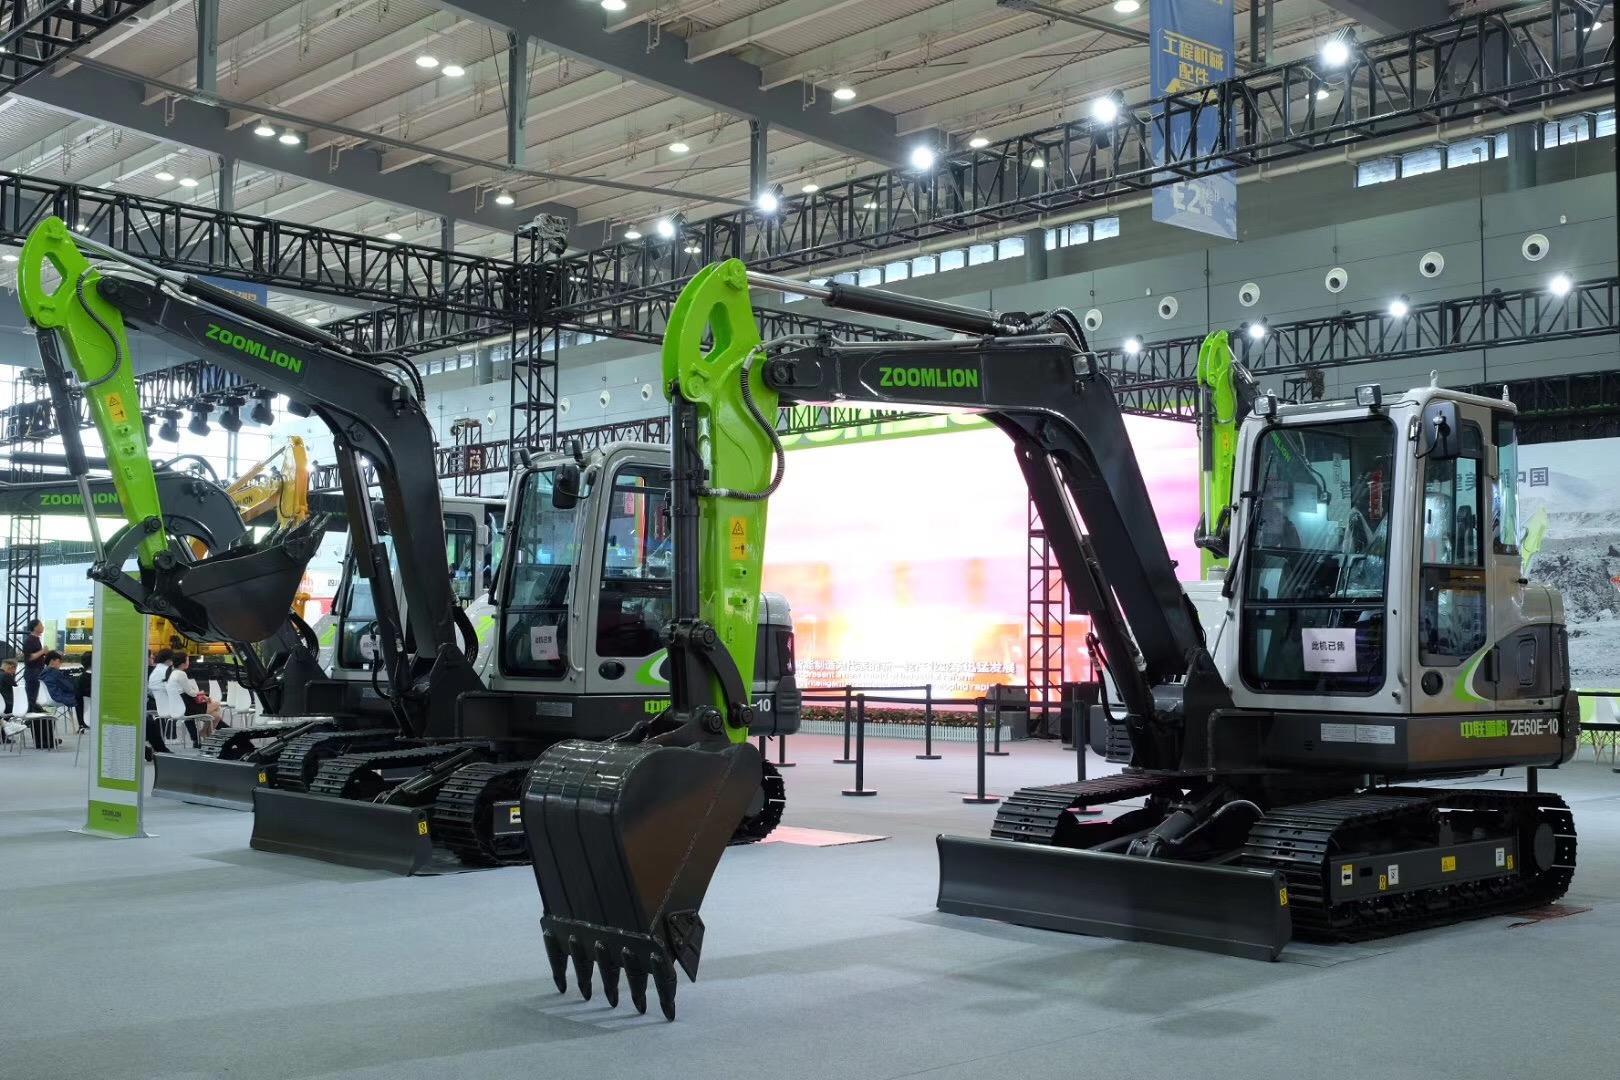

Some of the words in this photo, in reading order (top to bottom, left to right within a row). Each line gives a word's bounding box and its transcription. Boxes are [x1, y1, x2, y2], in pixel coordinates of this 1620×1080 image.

[1163, 35, 1224, 71] 工程机械
[1179, 61, 1209, 85] 配件
[1172, 182, 1204, 214] E2
[205, 322, 302, 374] ZOOMLION
[880, 367, 978, 388] ZOOMLION
[40, 493, 119, 506] ZOOMION
[1311, 640, 1345, 651] 此机已售
[1510, 718, 1559, 736] ZE60E-10
